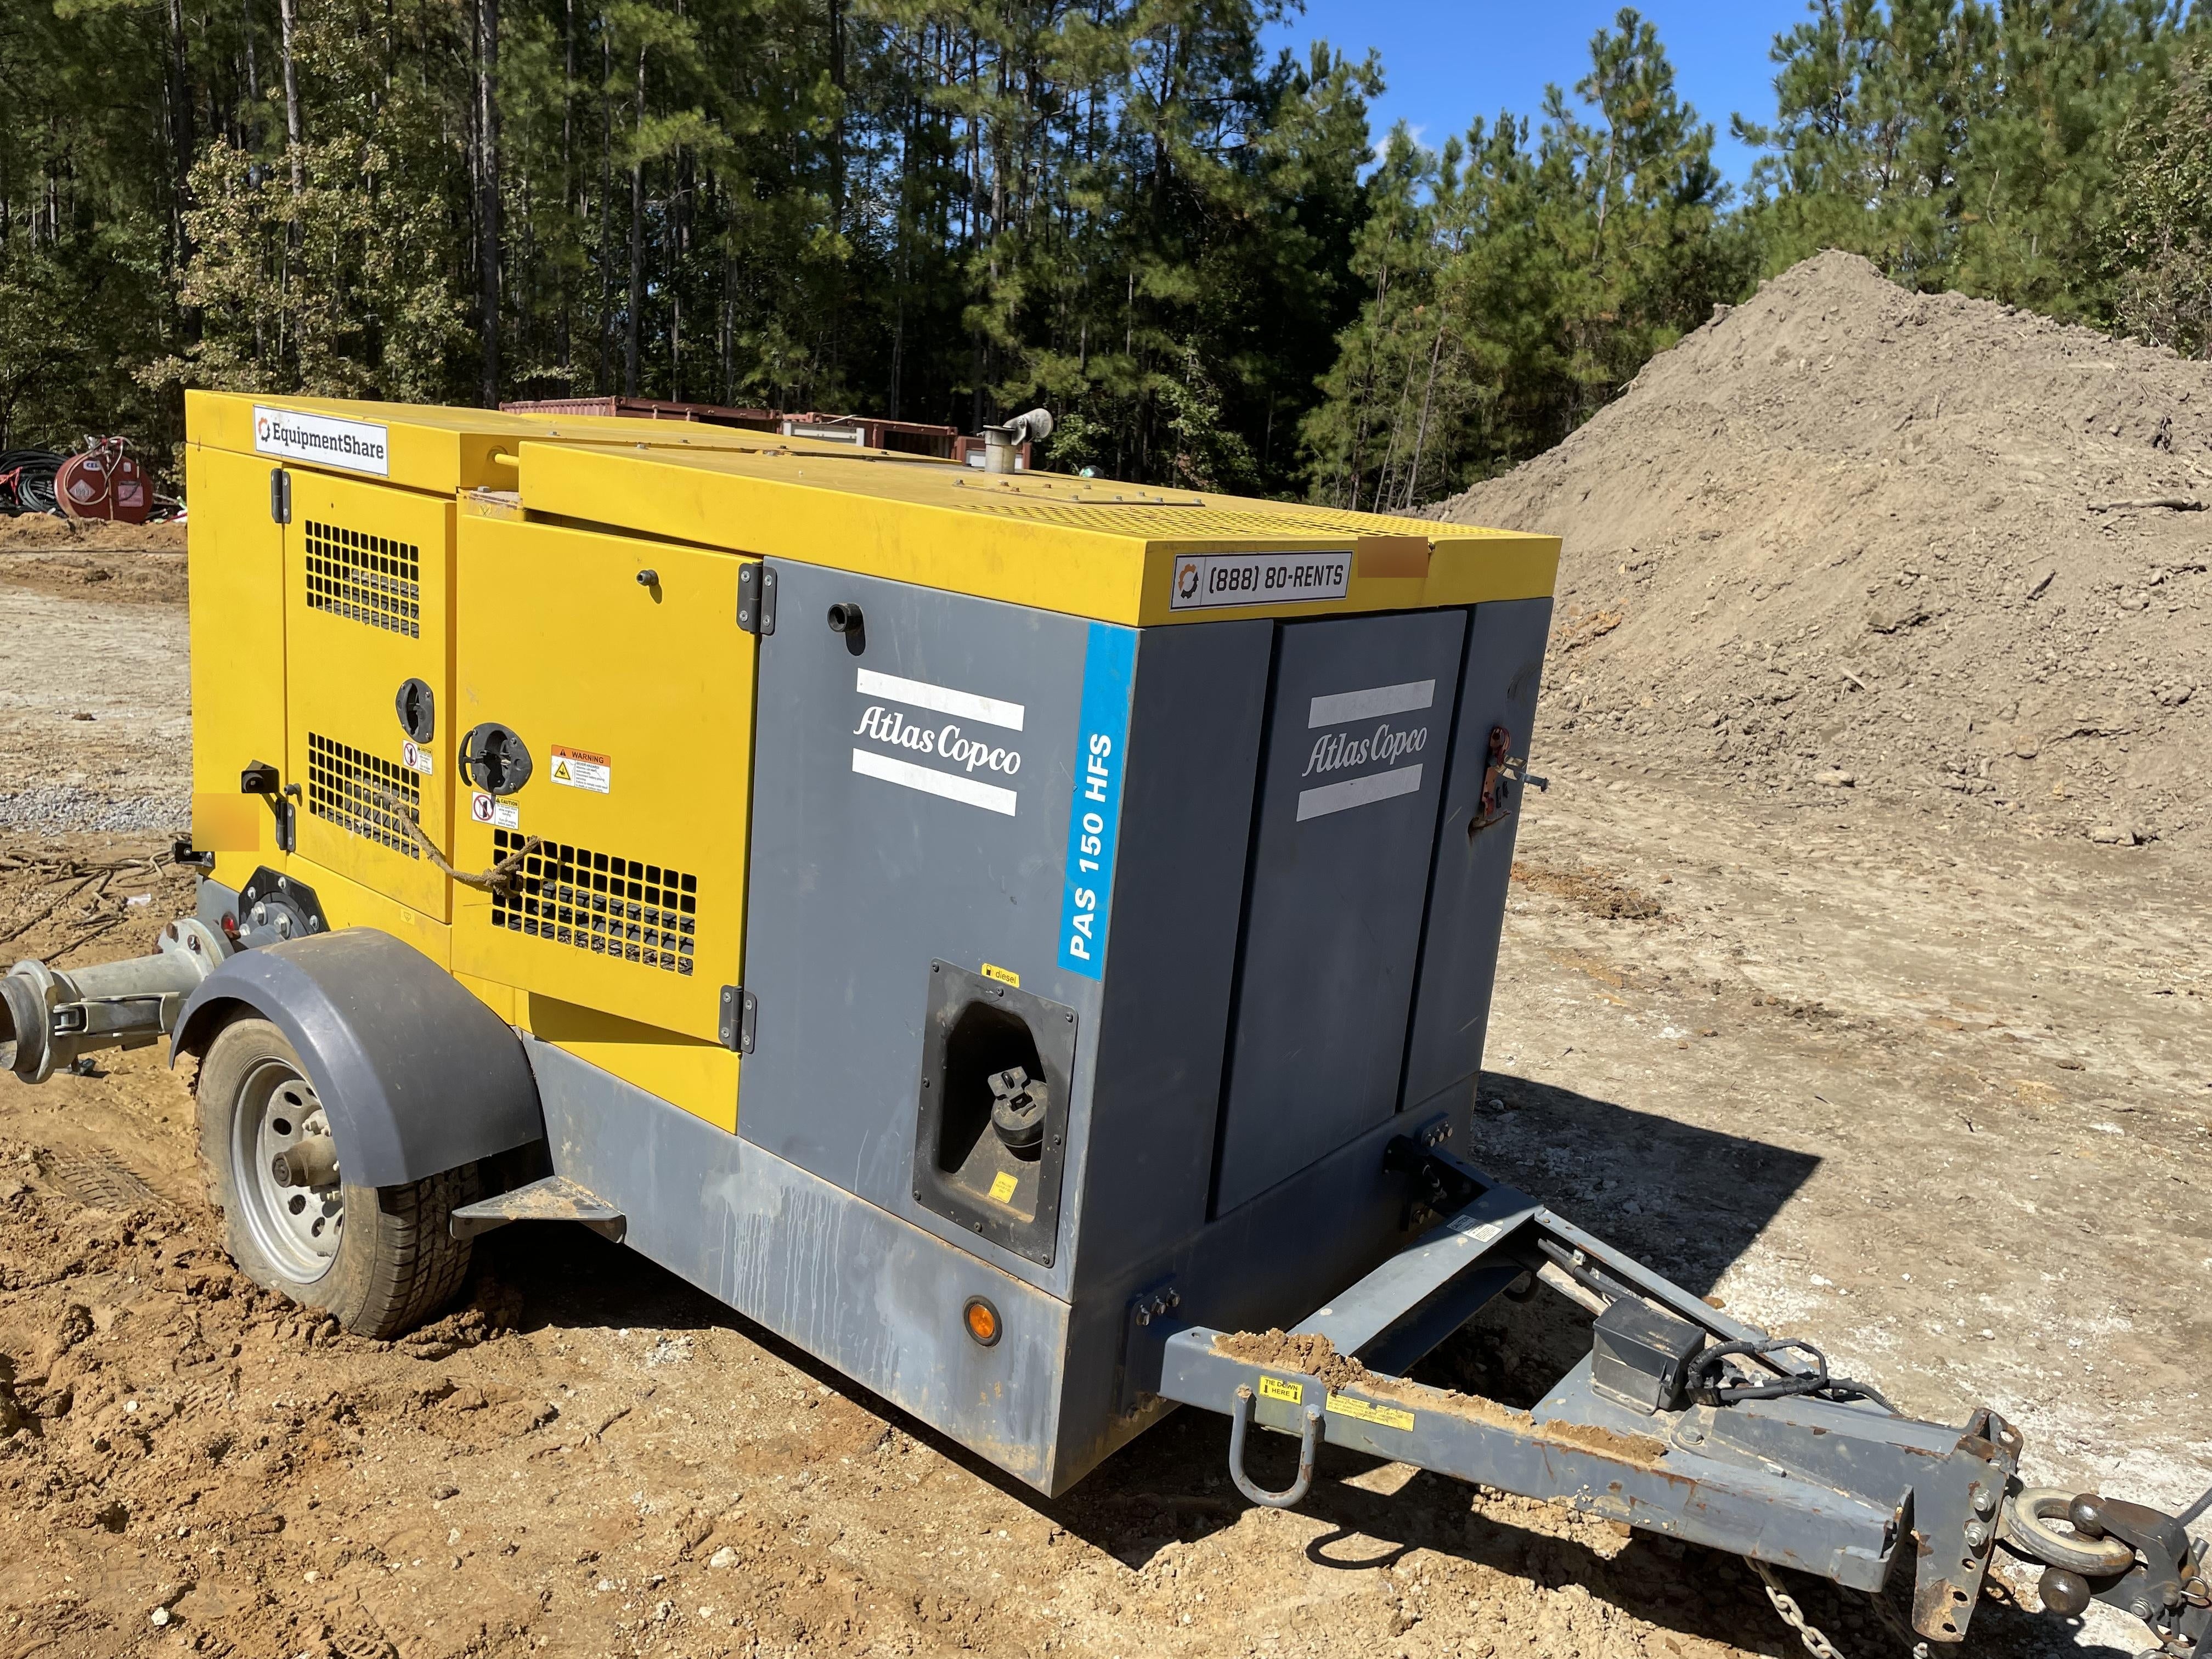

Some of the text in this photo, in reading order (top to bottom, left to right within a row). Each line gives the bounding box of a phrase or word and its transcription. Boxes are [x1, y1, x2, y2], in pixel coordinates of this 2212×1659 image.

[273, 422, 384, 460] EquipmentShare
[1209, 565, 1344, 594] (888) 80-RENTS
[853, 706, 1021, 775] Atlas Copco
[1302, 724, 1427, 777] Atlas Copco
[572, 751, 604, 764] WARNING
[500, 798, 518, 806] CAUTION
[1070, 733, 1112, 961] PAS 150 HFS
[996, 970, 1016, 984] diesel
[1272, 1388, 1290, 1397] HERE
